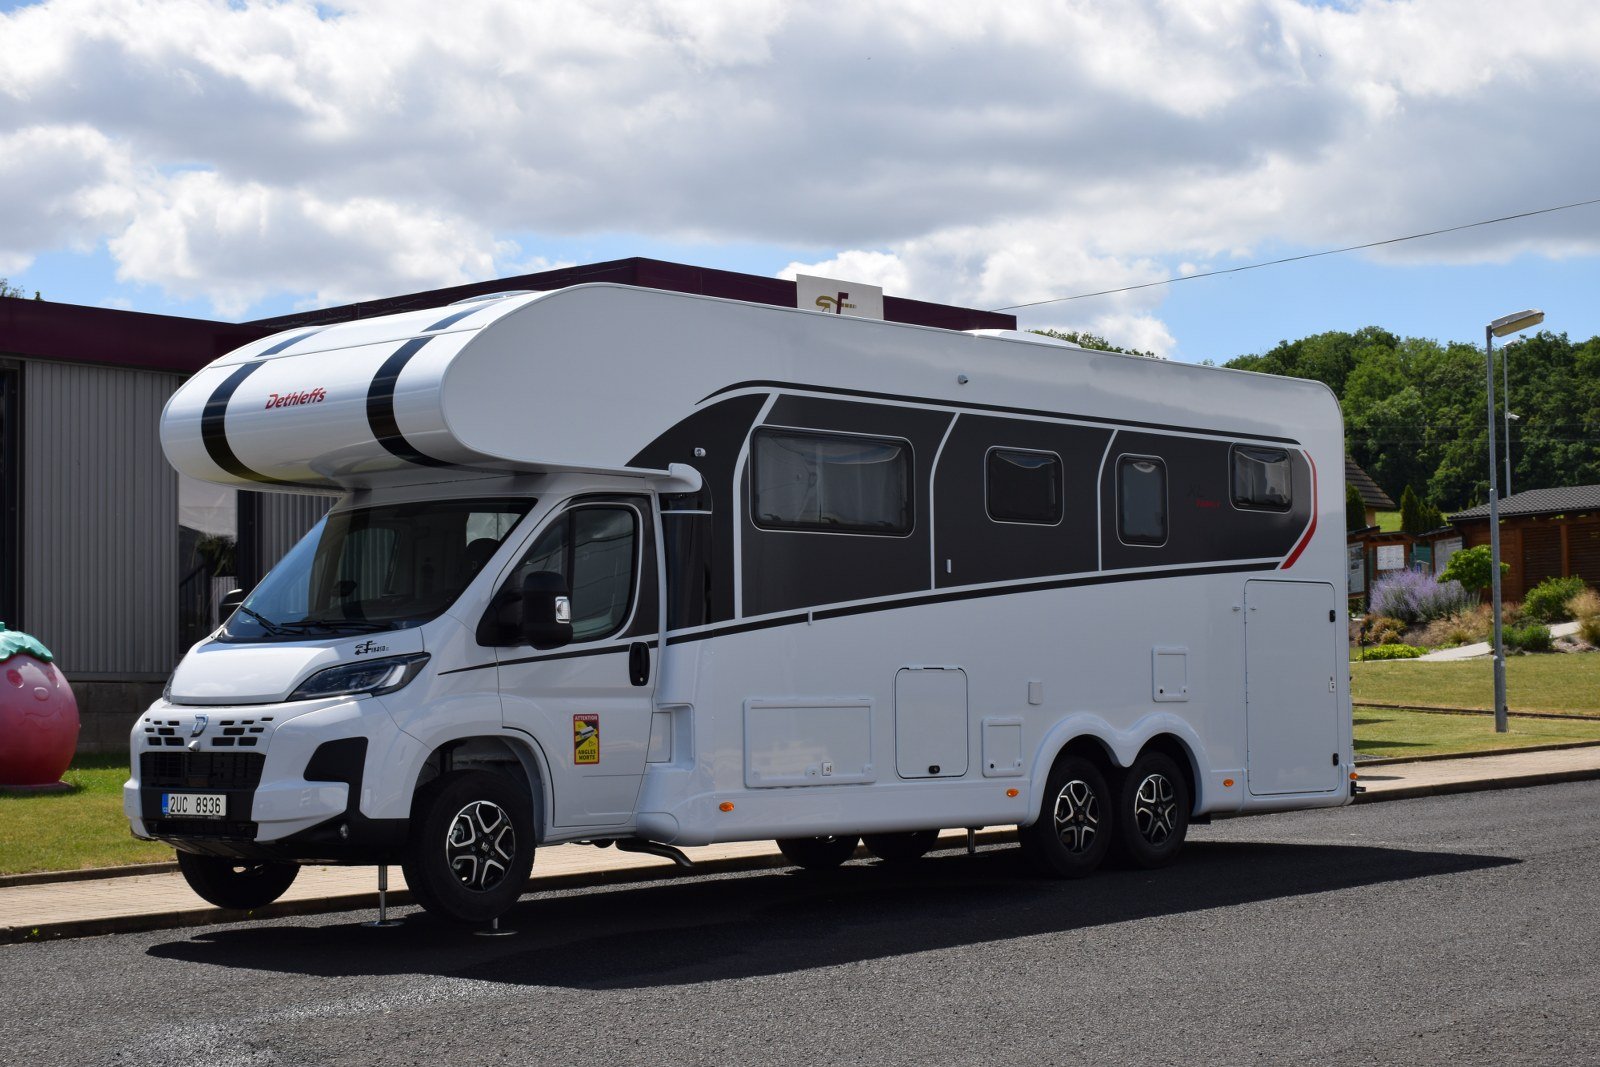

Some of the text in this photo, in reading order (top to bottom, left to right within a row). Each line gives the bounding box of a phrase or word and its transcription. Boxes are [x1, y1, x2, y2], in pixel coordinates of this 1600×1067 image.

[265, 387, 326, 409] Dethleffs
[170, 796, 221, 814] 2UC 8936
